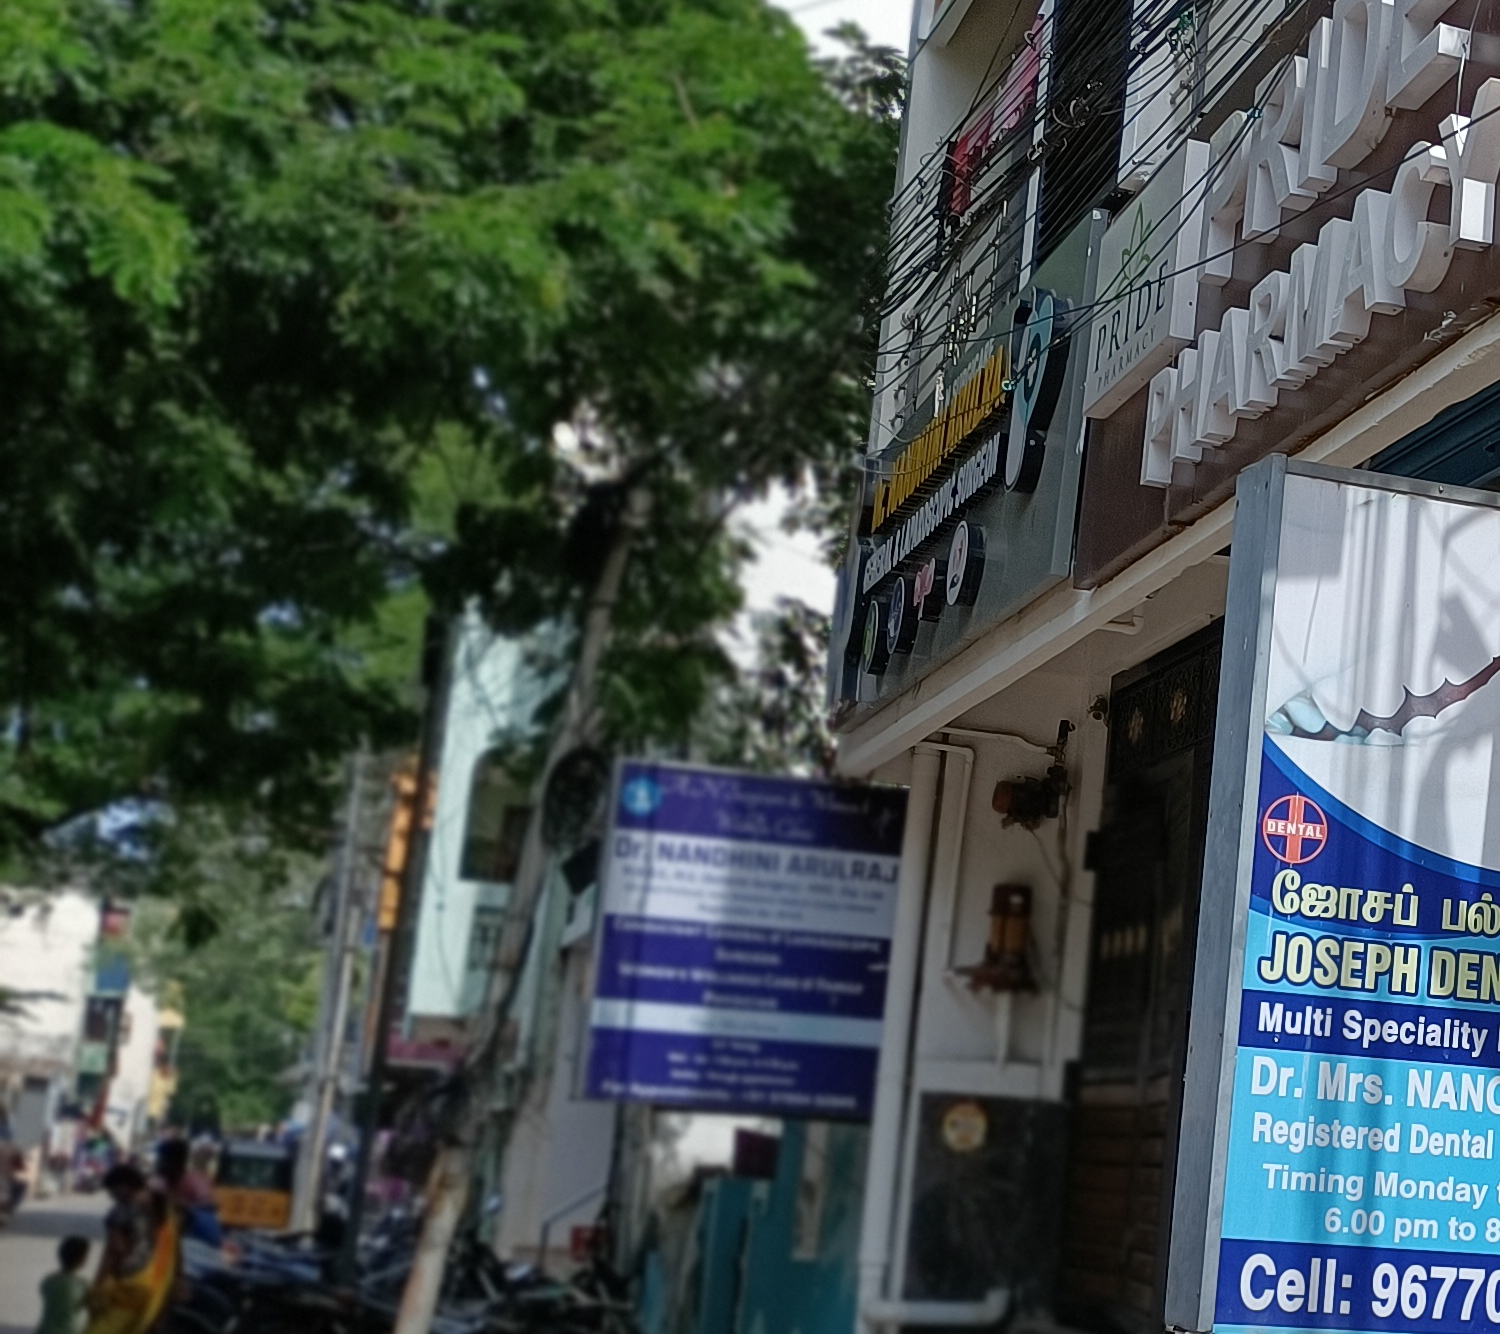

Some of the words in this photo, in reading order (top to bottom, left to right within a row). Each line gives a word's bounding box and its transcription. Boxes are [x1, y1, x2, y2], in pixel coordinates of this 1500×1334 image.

[1094, 259, 1168, 373] PRIDE
[1097, 325, 1155, 392] PHARMACY
[1267, 821, 1323, 840] DENTAL
[1272, 869, 1419, 927] ஜோசப்
[1261, 934, 1419, 993] JOSEPH
[1258, 1003, 1331, 1038] Multi
[1343, 1010, 1488, 1056] Speciality
[1251, 1056, 1303, 1098] Dr.
[1317, 1062, 1394, 1106] Mrs.
[1252, 1113, 1400, 1153] Registered
[1409, 1124, 1493, 1160] Dental
[1262, 1163, 1364, 1201] Timing
[1375, 1172, 1488, 1210] Monday
[1324, 1208, 1385, 1236] 6.00
[1394, 1218, 1438, 1244] pm
[1449, 1217, 1476, 1242] to
[1240, 1254, 1353, 1315] Cell:
